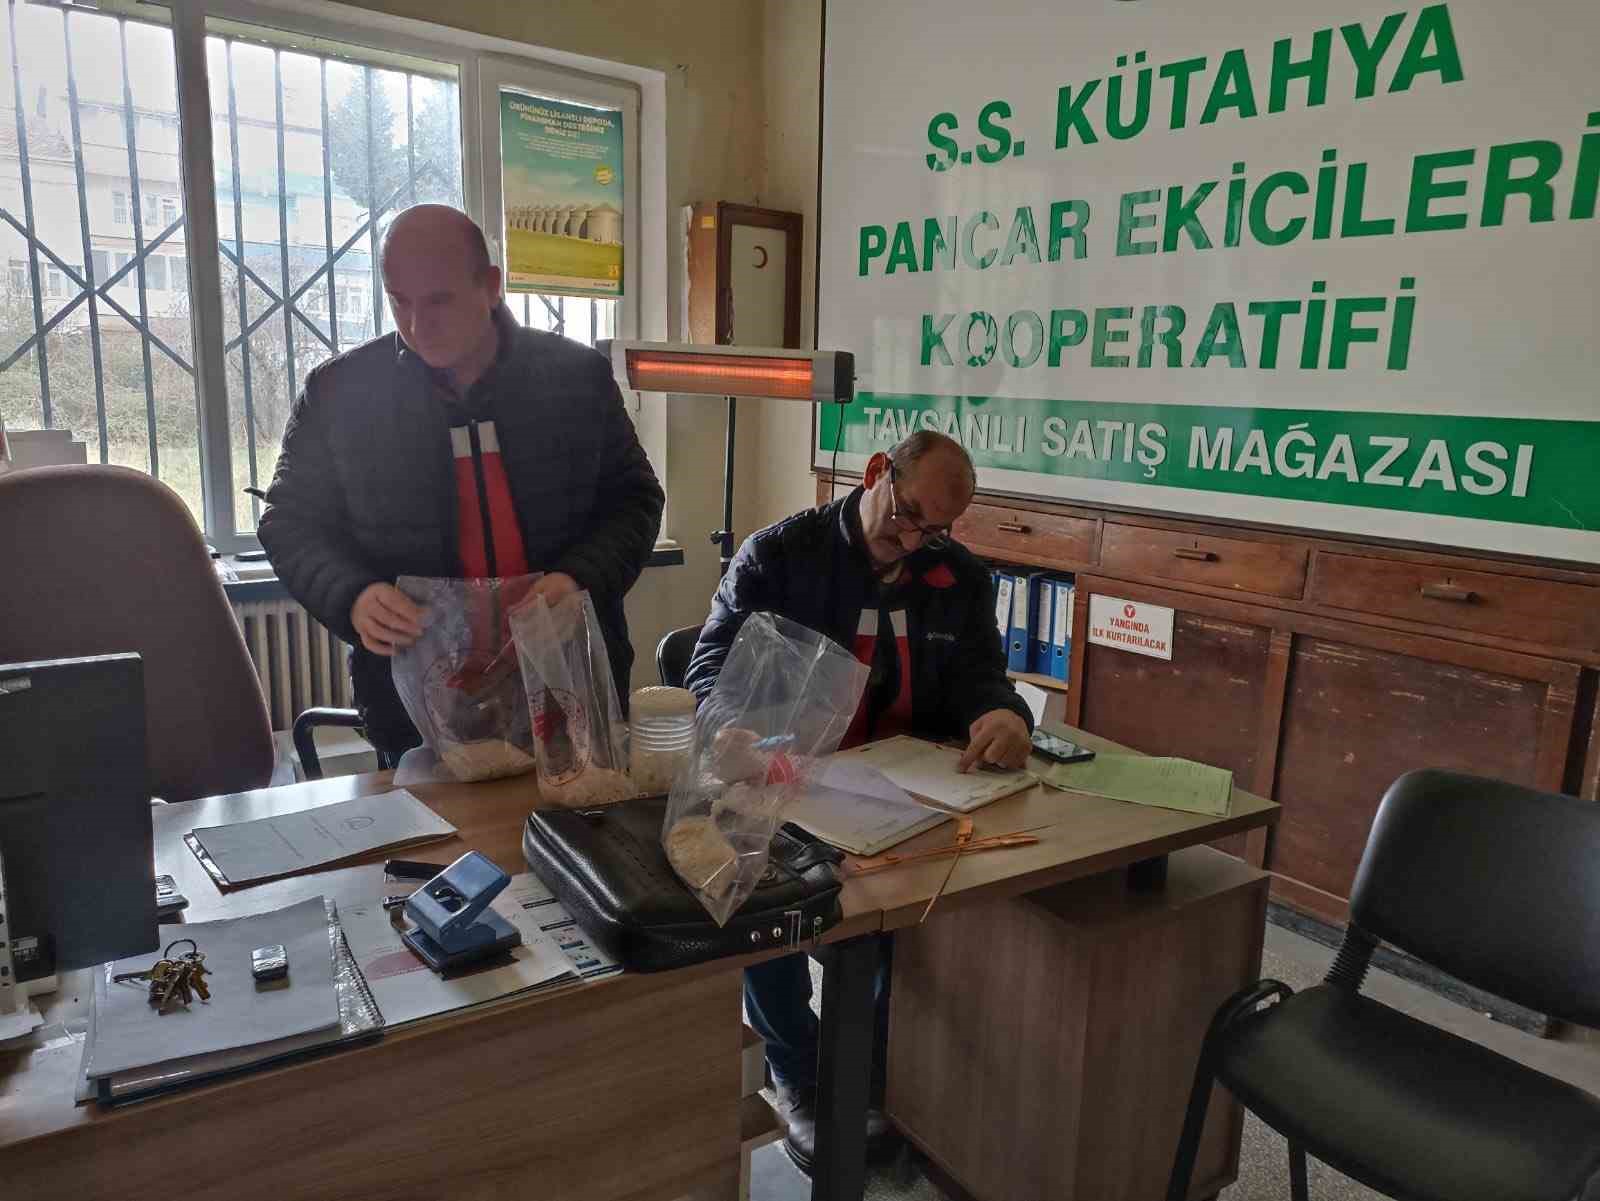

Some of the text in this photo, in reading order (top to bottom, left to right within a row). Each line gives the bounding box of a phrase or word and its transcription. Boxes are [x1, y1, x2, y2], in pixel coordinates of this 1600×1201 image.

[926, 3, 1464, 172] S.S. KÜTAHYA
[858, 111, 1600, 277] PANCAR EKİCİLERİ
[920, 277, 1416, 371] KOOPERATİFİ
[1042, 416, 1167, 478] SATIŞ
[1187, 422, 1534, 498] MAĞAZASI
[1106, 629, 1167, 652] KURTARILACAK
[1110, 616, 1149, 633] YANGINDA
